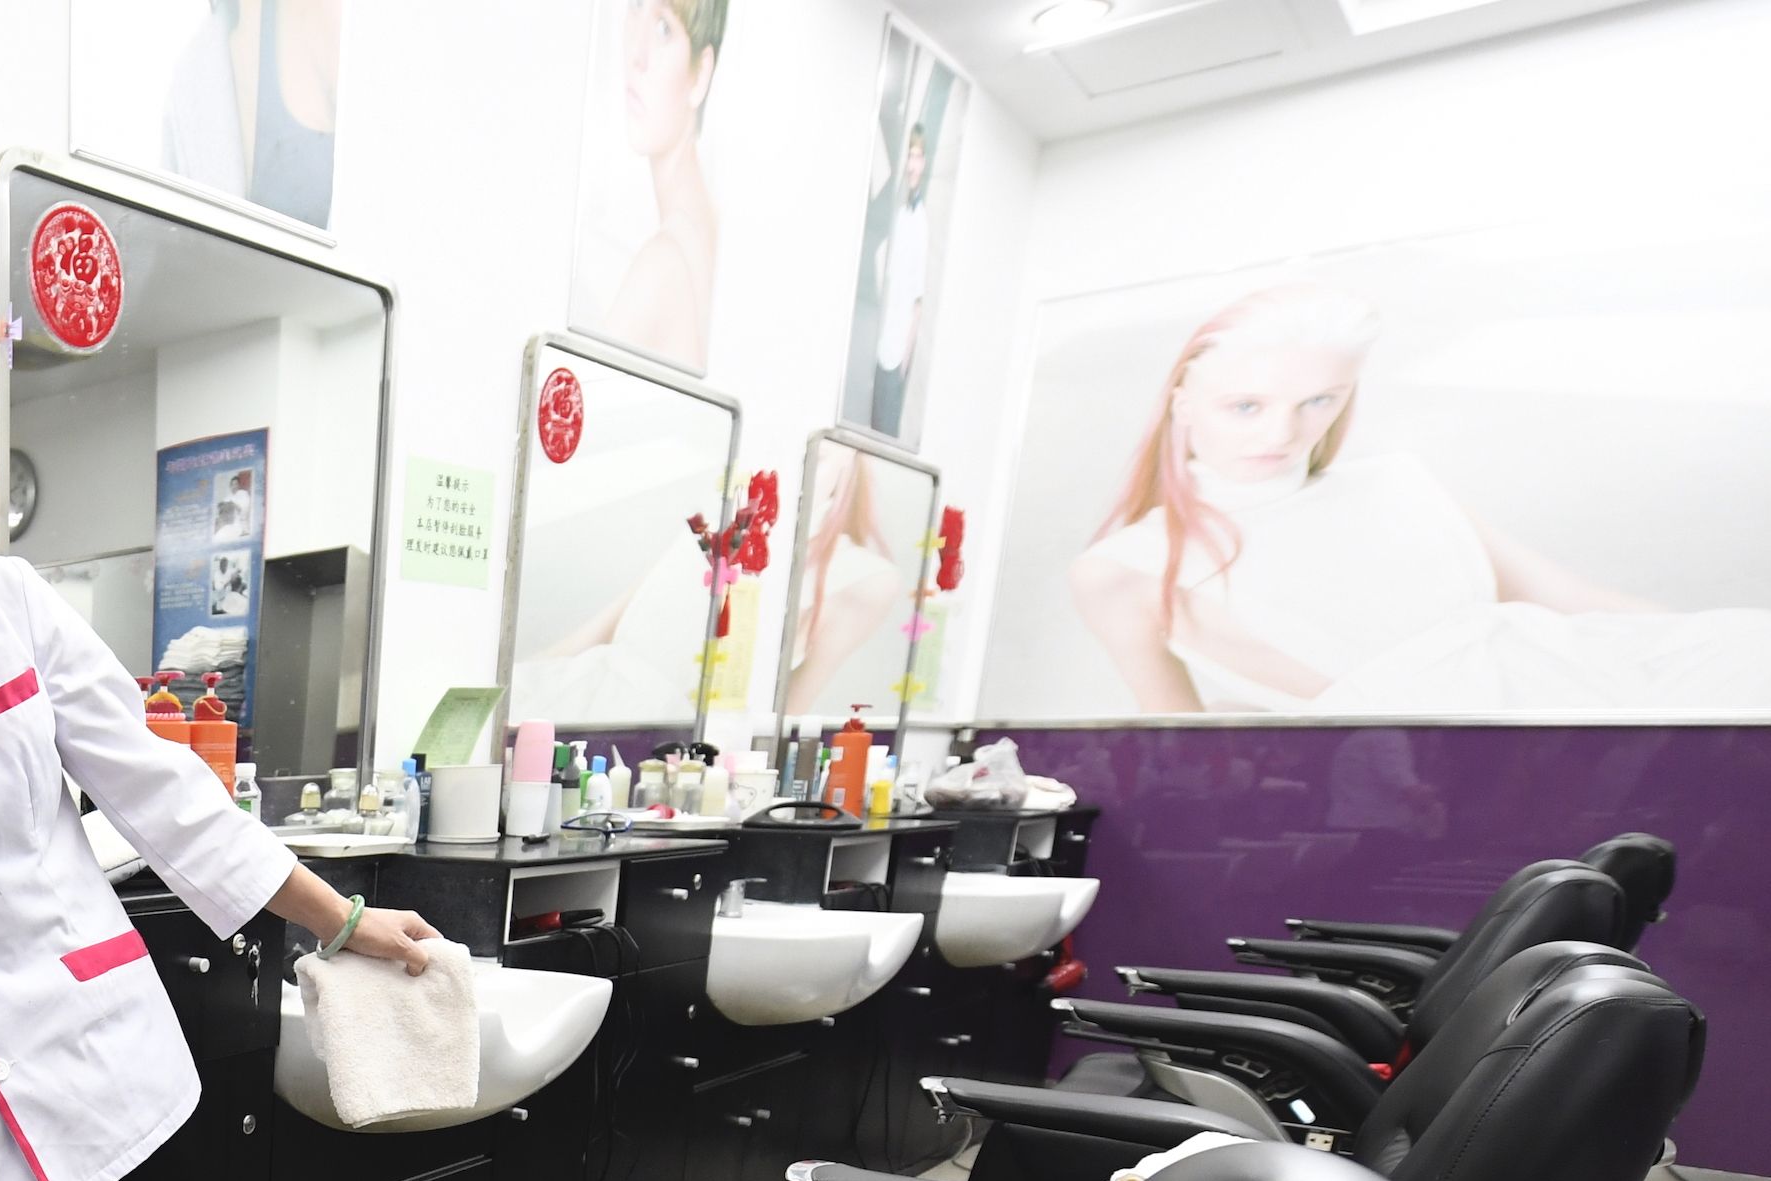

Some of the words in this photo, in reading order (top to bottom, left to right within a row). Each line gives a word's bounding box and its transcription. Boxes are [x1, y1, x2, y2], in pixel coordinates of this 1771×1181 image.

[58, 216, 99, 285] 福
[436, 474, 468, 492] 温馨提示
[427, 496, 476, 515] 为了您的安全
[417, 517, 483, 539] 本店暂停刮脸服务
[406, 539, 488, 560] 理发时建议您佩戴口罩
